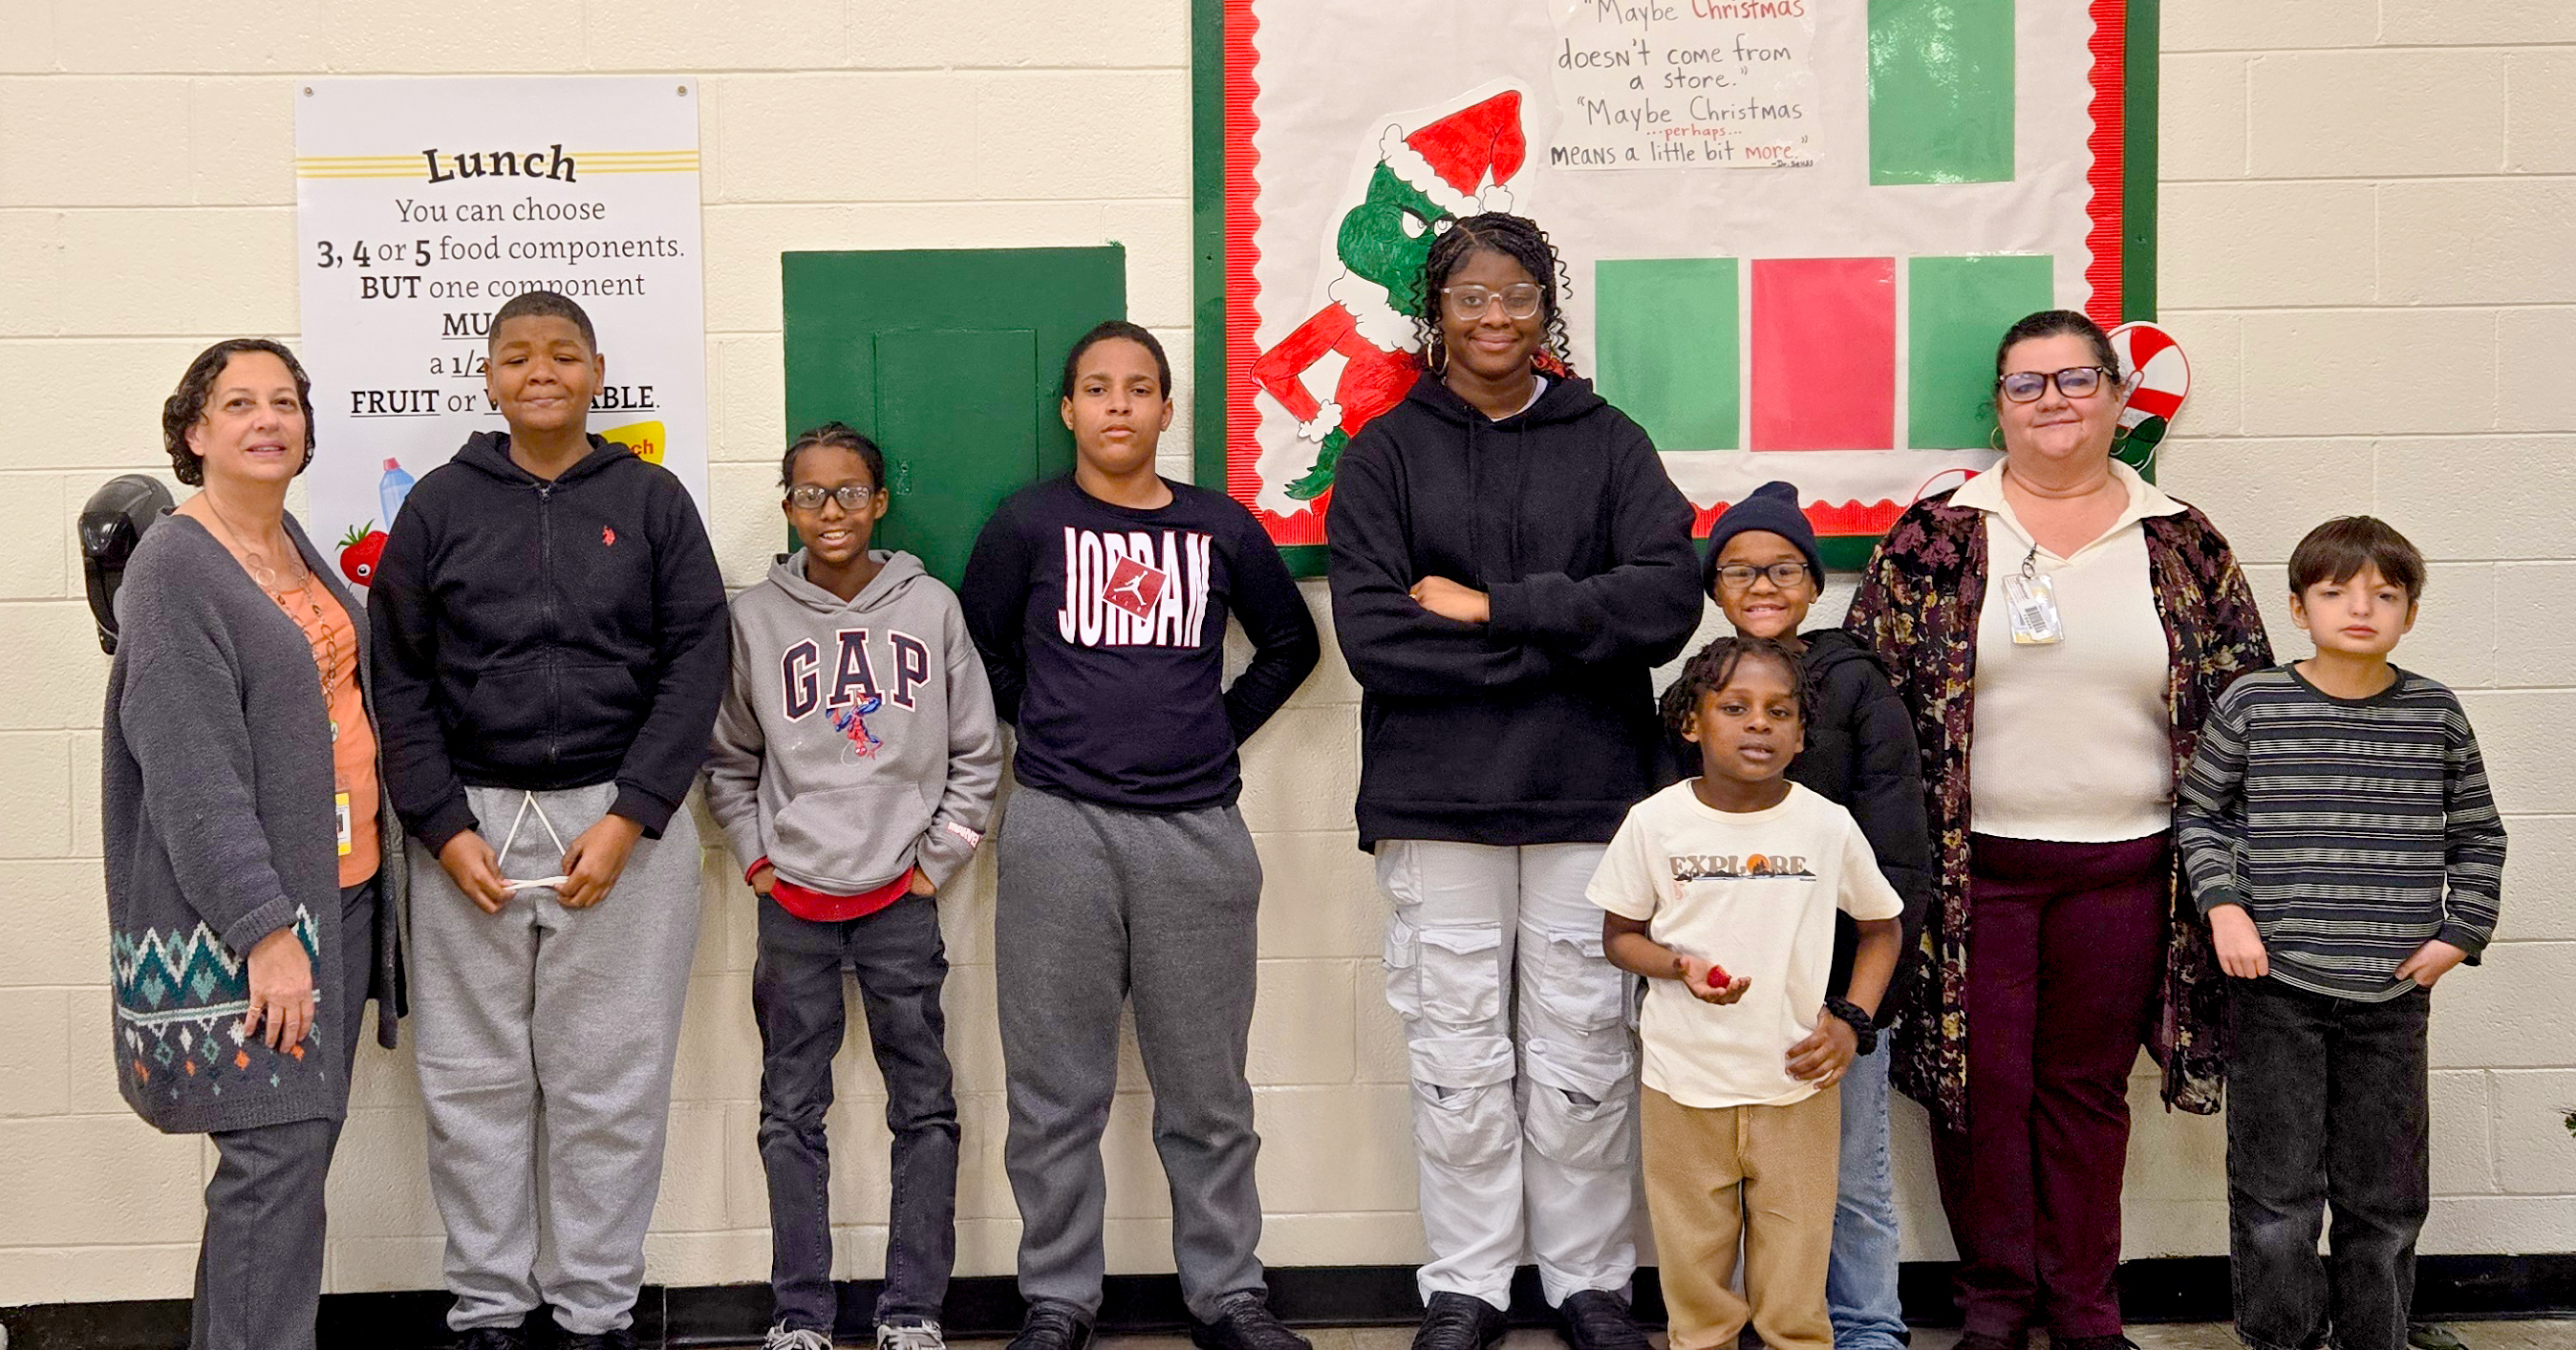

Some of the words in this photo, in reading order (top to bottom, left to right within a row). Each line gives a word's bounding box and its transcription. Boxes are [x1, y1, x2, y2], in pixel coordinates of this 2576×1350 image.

[1691, 0, 1805, 20] Christmas
[1666, 48, 1724, 64] come
[1732, 32, 1792, 62] from
[1629, 76, 1644, 90] a
[1689, 96, 1803, 121] Christmas
[422, 144, 577, 183] Lunch
[1624, 147, 1640, 161] a
[1650, 141, 1696, 162] little
[1705, 140, 1735, 161] bit
[395, 198, 449, 223] You
[456, 202, 505, 222] can
[512, 196, 607, 221] choose
[316, 240, 343, 269] 3,
[352, 239, 372, 268] 4
[377, 244, 407, 261] or
[415, 239, 431, 267] 5
[439, 235, 502, 260] food
[508, 234, 685, 265] components.
[359, 275, 421, 300] BUT
[429, 279, 480, 298] one
[487, 273, 646, 298] component
[441, 312, 492, 335] MU
[430, 357, 444, 375] a
[351, 389, 440, 414] FRUIT
[447, 395, 477, 412] or
[781, 628, 932, 723] GAP
[1669, 853, 1807, 877] EXPLORE
